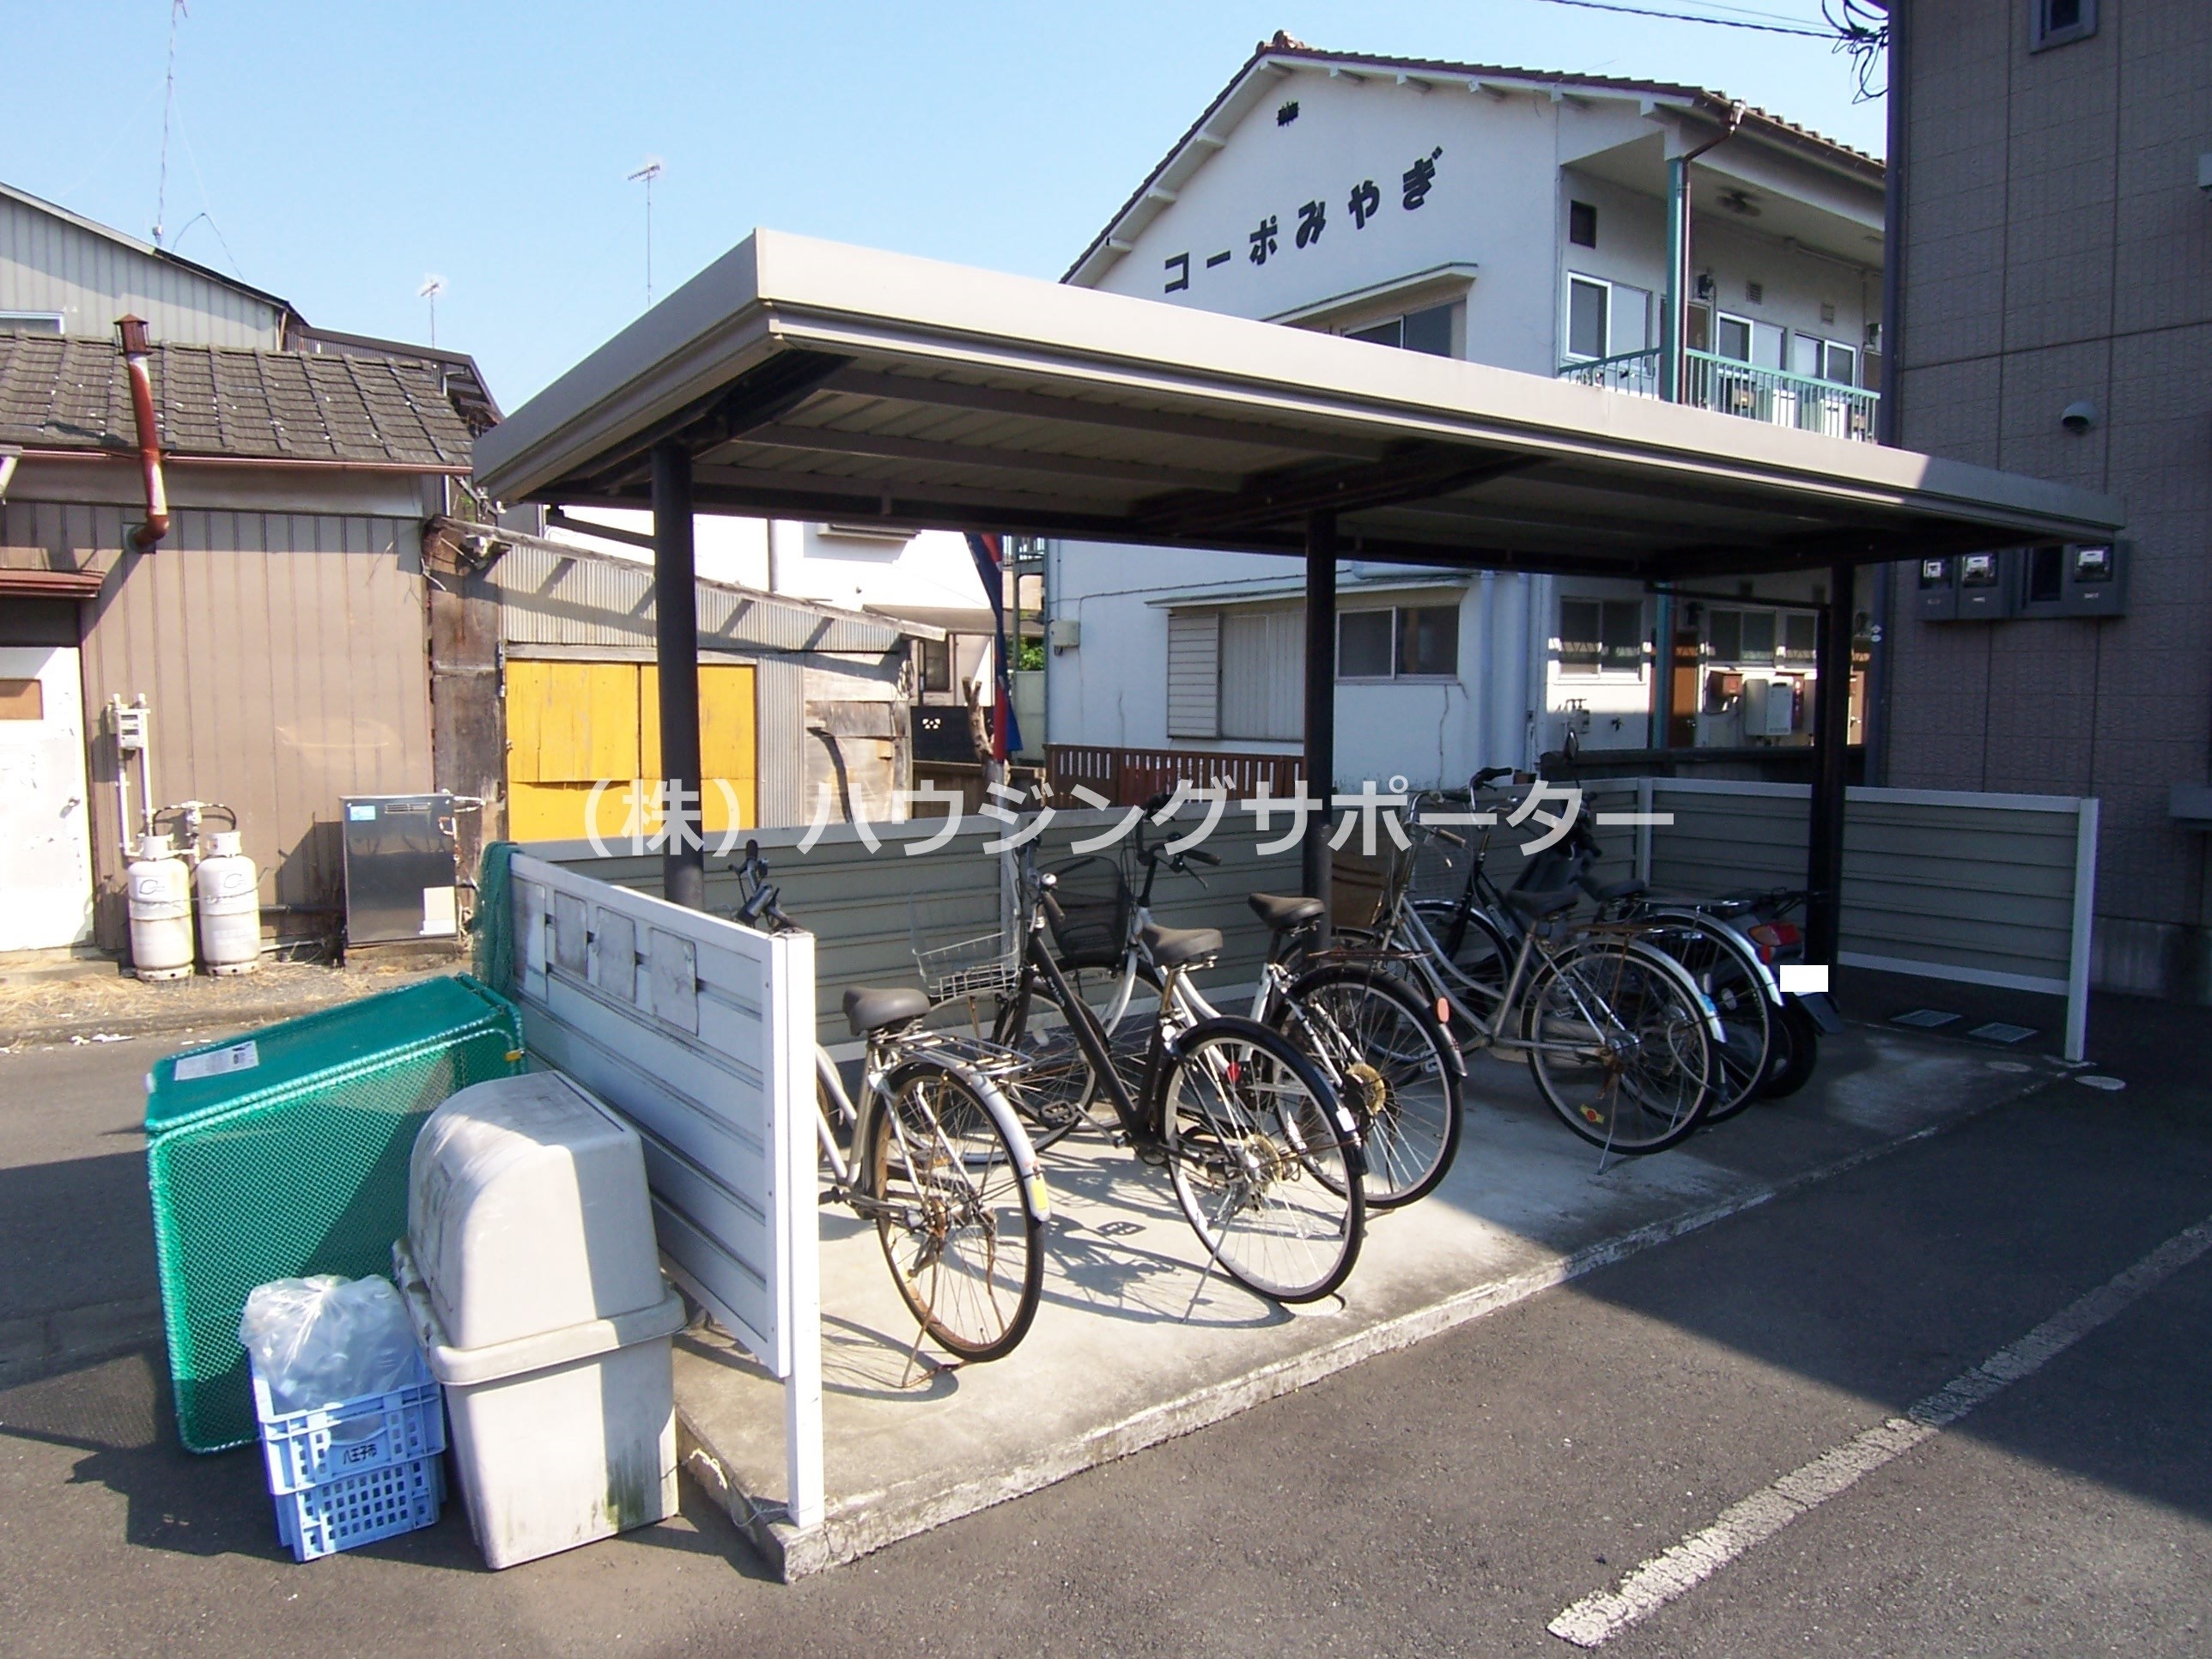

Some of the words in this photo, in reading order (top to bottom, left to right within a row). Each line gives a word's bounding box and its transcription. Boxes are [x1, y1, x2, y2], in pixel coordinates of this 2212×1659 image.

[1164, 146, 1443, 294] コーポみやぎ
[343, 1443, 377, 1464] 八王子市
